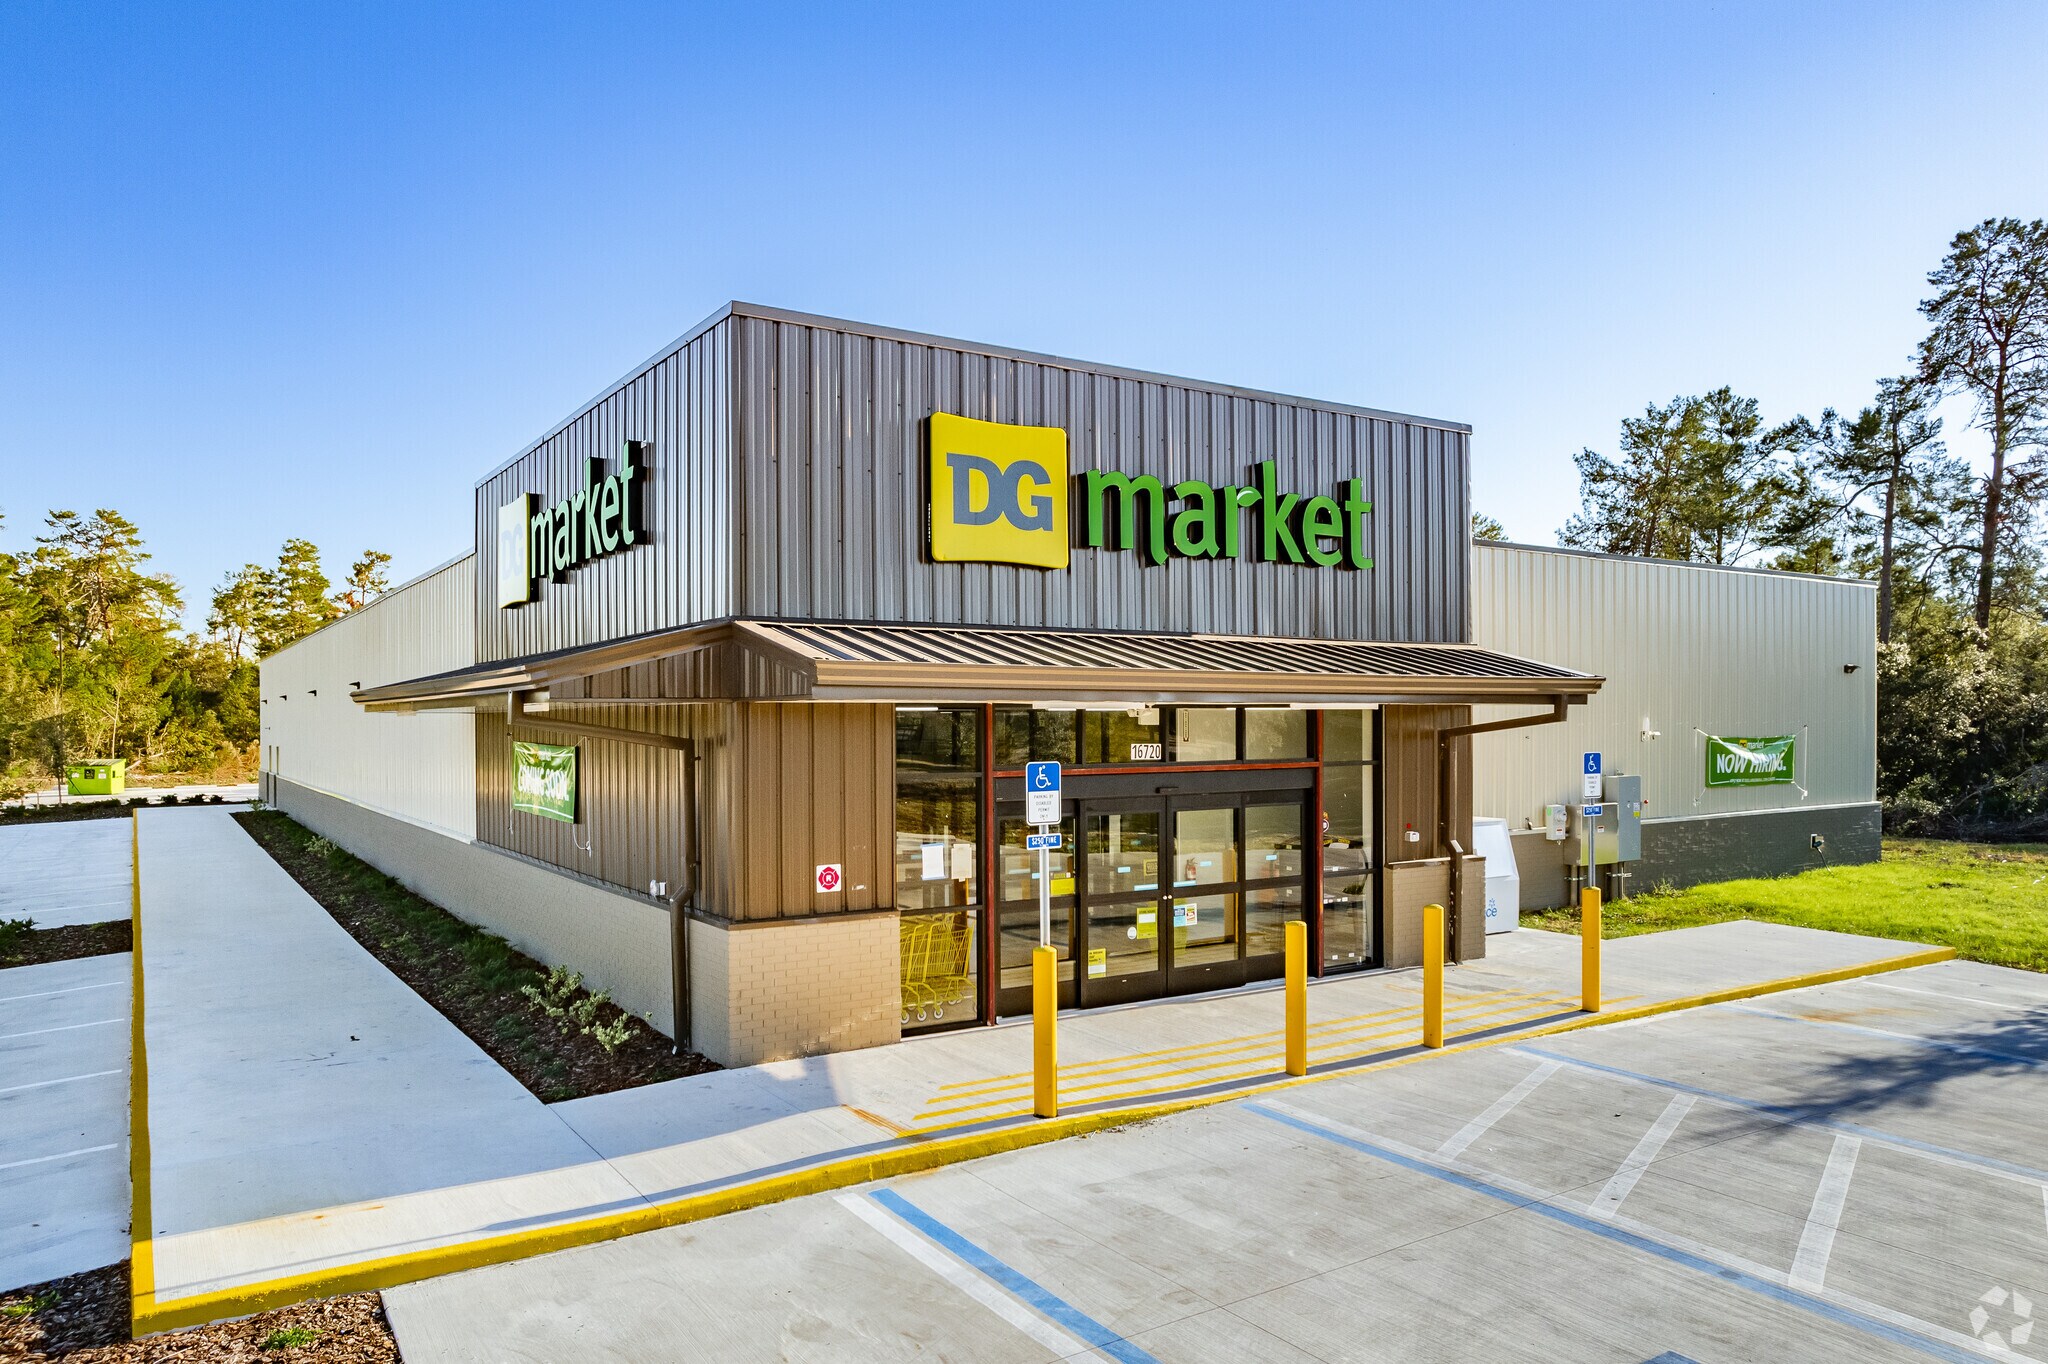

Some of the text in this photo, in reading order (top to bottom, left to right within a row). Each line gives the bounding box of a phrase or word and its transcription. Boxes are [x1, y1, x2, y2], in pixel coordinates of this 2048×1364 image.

[530, 439, 635, 584] market
[946, 452, 1374, 571] DG market
[1132, 744, 1160, 759] 16720
[1716, 753, 1748, 774] NOW
[1031, 836, 1057, 846] $250 FINE
[1486, 907, 1497, 918] ce
